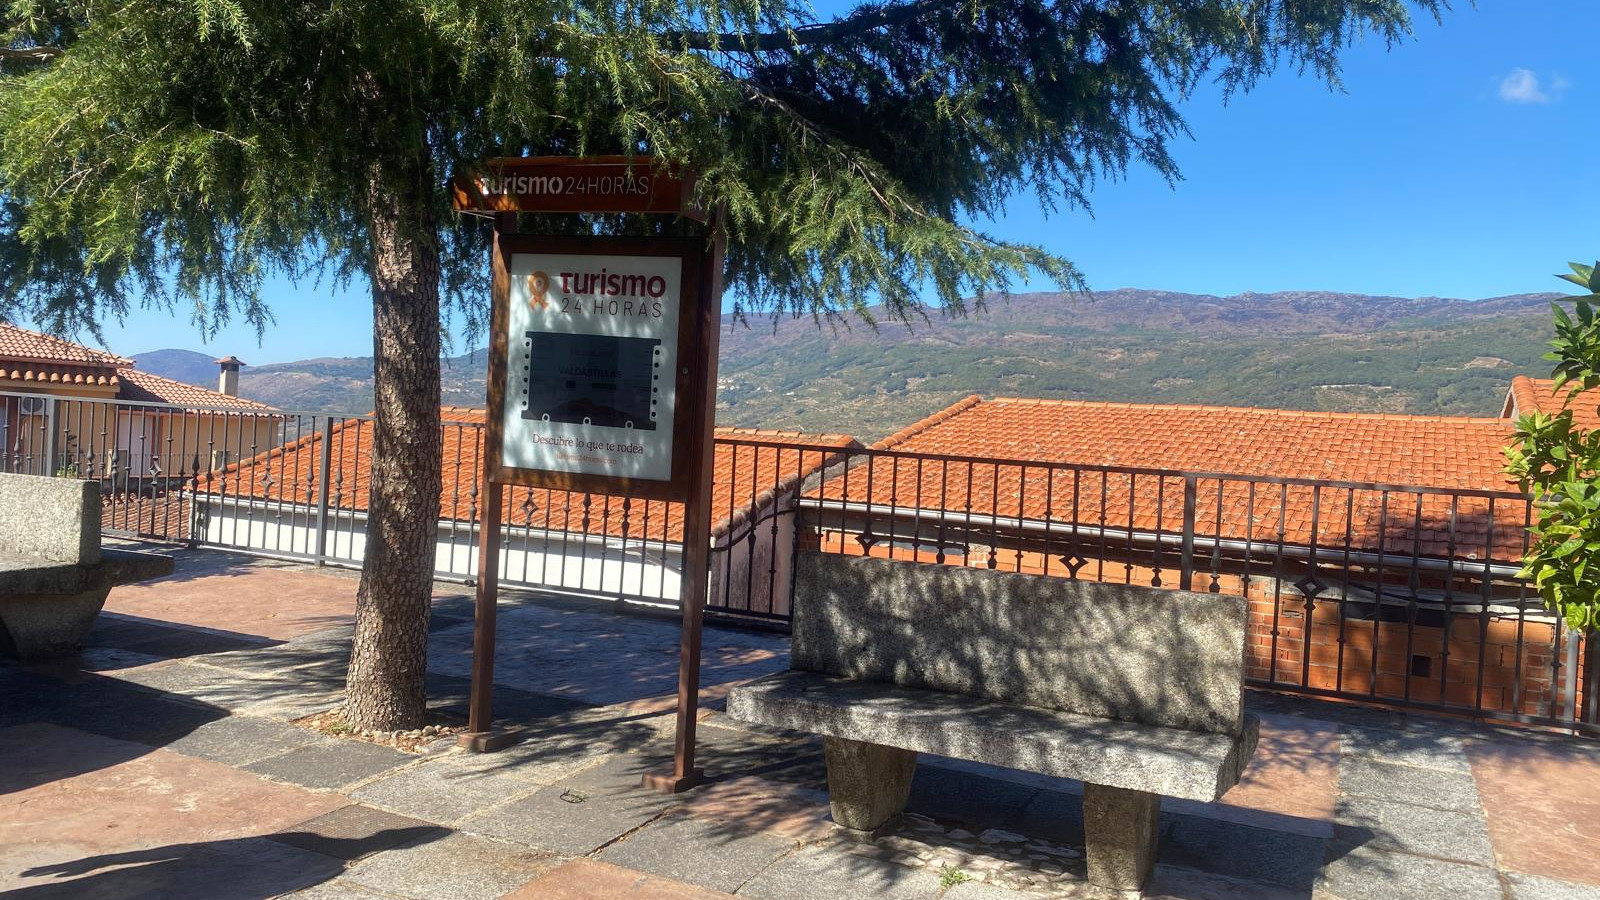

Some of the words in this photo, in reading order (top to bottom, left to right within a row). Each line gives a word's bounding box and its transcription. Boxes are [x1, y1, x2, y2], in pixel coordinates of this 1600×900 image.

[560, 268, 666, 298] turismo
[561, 298, 582, 314] 24
[594, 301, 662, 318] HORAS
[532, 433, 574, 448] Descubre
[576, 438, 585, 448] lo
[586, 441, 603, 451] que
[606, 442, 615, 452] te
[617, 444, 644, 454] rodea
